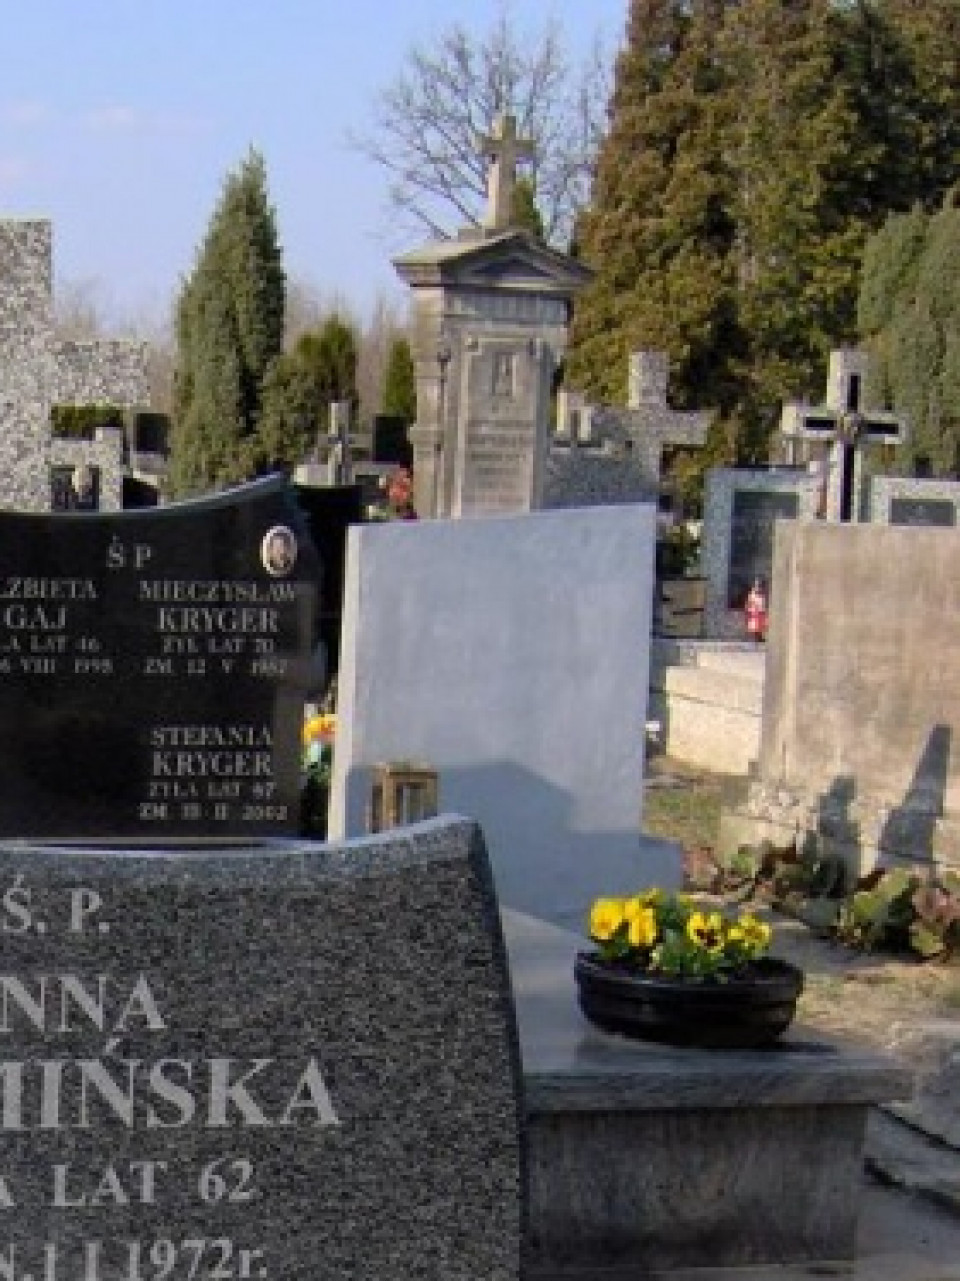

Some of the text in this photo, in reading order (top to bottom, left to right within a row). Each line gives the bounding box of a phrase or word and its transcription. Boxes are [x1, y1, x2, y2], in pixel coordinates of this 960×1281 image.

[3, 604, 68, 629] GAJ
[157, 607, 280, 633] KRYGER
[150, 725, 274, 748] STEFANIA
[152, 751, 274, 777] KRYGER
[71, 890, 110, 933] P.
[51, 1161, 168, 1207] LAT
[197, 1157, 258, 1201] 62
